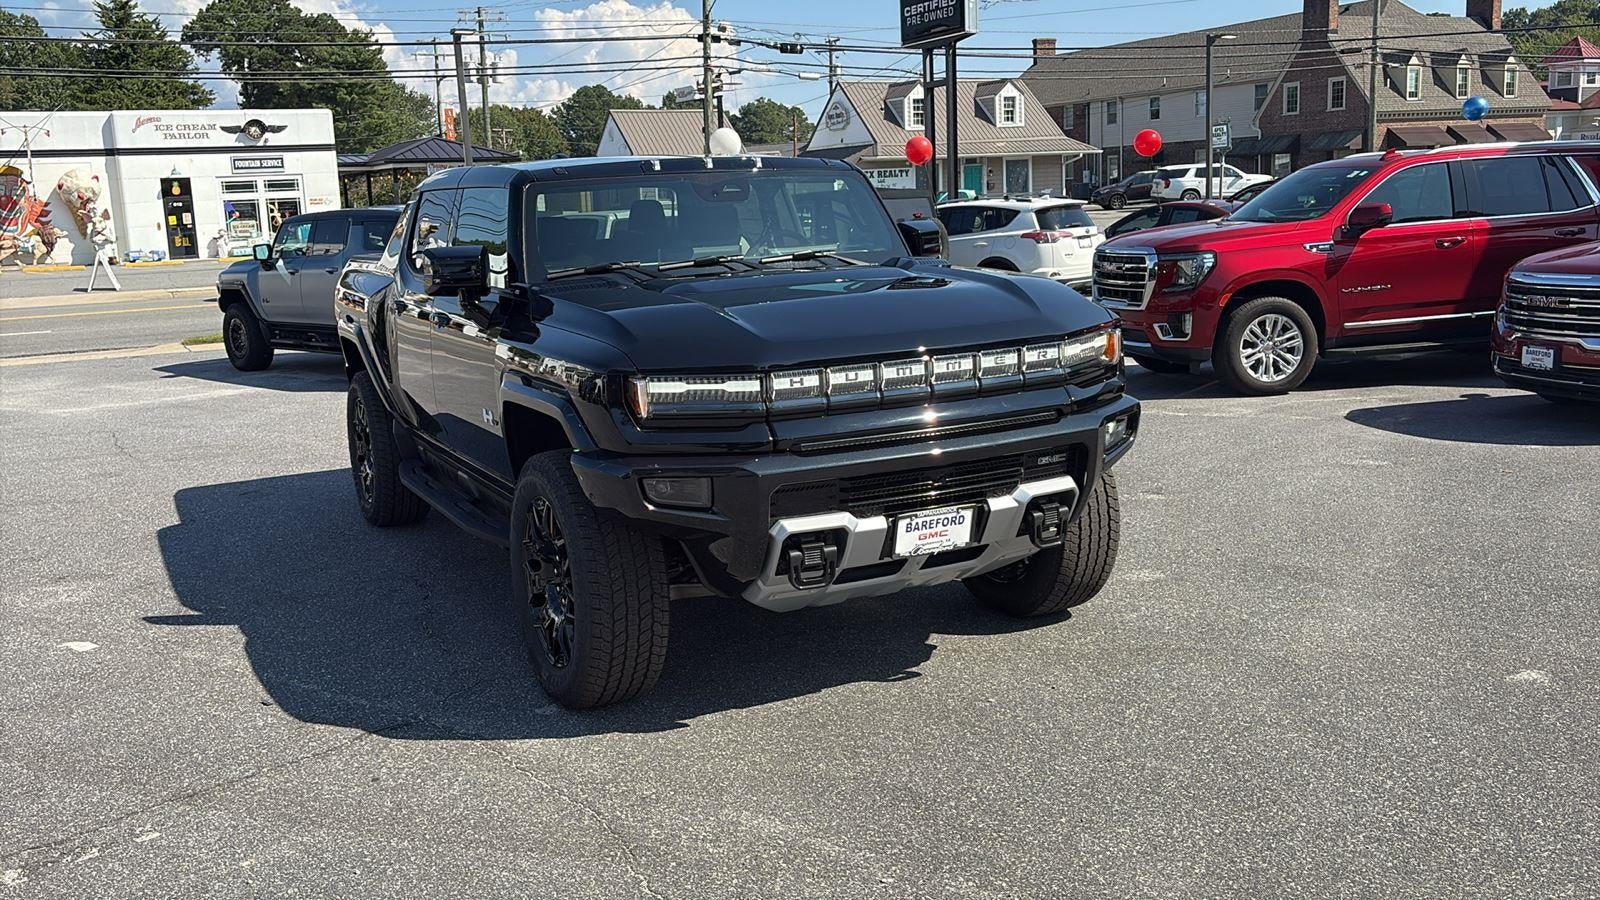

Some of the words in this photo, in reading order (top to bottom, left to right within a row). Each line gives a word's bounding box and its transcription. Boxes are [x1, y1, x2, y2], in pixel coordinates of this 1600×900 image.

[906, 7, 954, 27] PRE-OWNED
[155, 123, 173, 132] ICE
[175, 123, 217, 131] CREAM
[163, 132, 210, 140] PARLOR
[235, 160, 261, 168] FOUNTAIN
[261, 159, 283, 167] SERVICE
[877, 169, 910, 178] REALTY
[1527, 295, 1569, 308] GMC
[1525, 349, 1551, 358] BAREFORD
[789, 350, 1048, 388] HUMMER
[1037, 453, 1067, 465] GMC
[906, 515, 965, 532] BAREFORD
[919, 530, 949, 541] GMC
